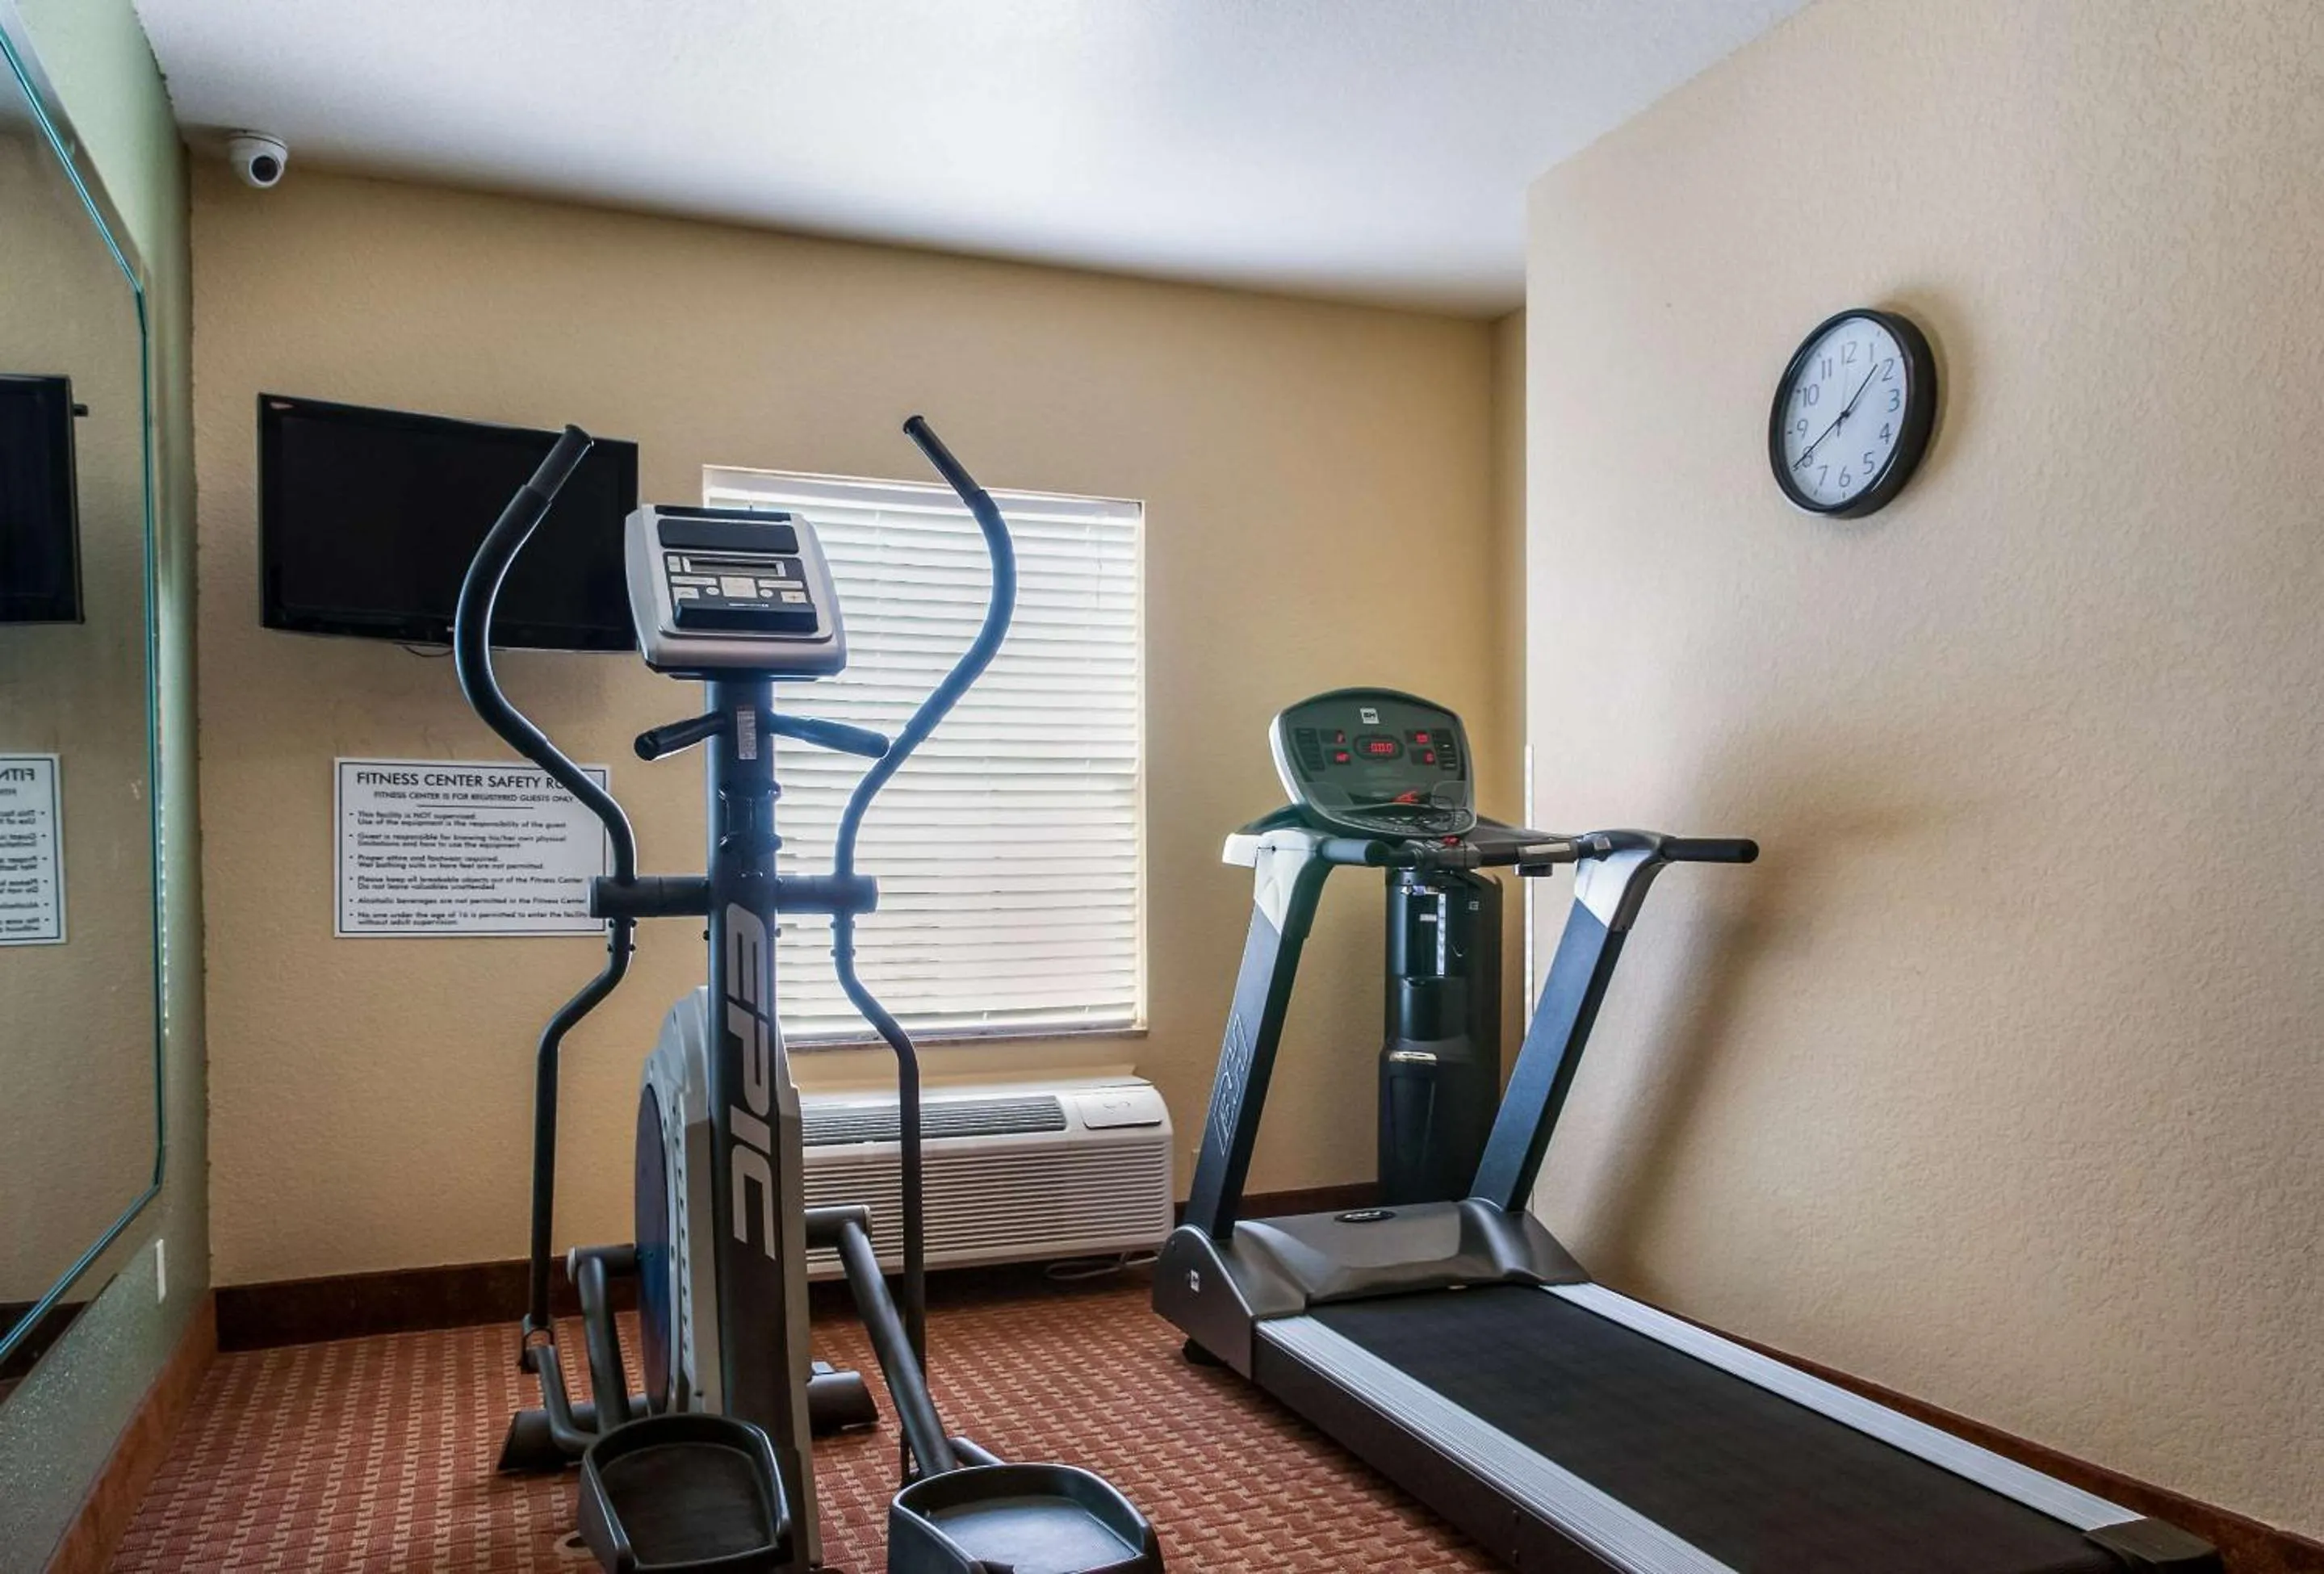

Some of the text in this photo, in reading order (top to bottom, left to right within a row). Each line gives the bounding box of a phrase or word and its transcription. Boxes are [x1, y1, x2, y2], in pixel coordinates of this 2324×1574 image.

[1840, 341, 1857, 365] 12
[1869, 342, 1874, 362] 1
[1821, 358, 1832, 380] 11
[1882, 358, 1895, 382] 2
[1803, 384, 1819, 408] 10
[1887, 389, 1900, 412] 3
[1797, 419, 1808, 438] 9
[1879, 423, 1892, 444] 4
[1801, 446, 1815, 468] 8
[1863, 451, 1875, 475] 5
[1817, 465, 1828, 486] 7
[1839, 466, 1851, 488] 6
[357, 772, 419, 785] FITNESS
[424, 774, 483, 787] CENTER
[488, 776, 541, 789] SAFETY
[552, 795, 574, 803] ONLY
[727, 902, 776, 1261] EPIC
